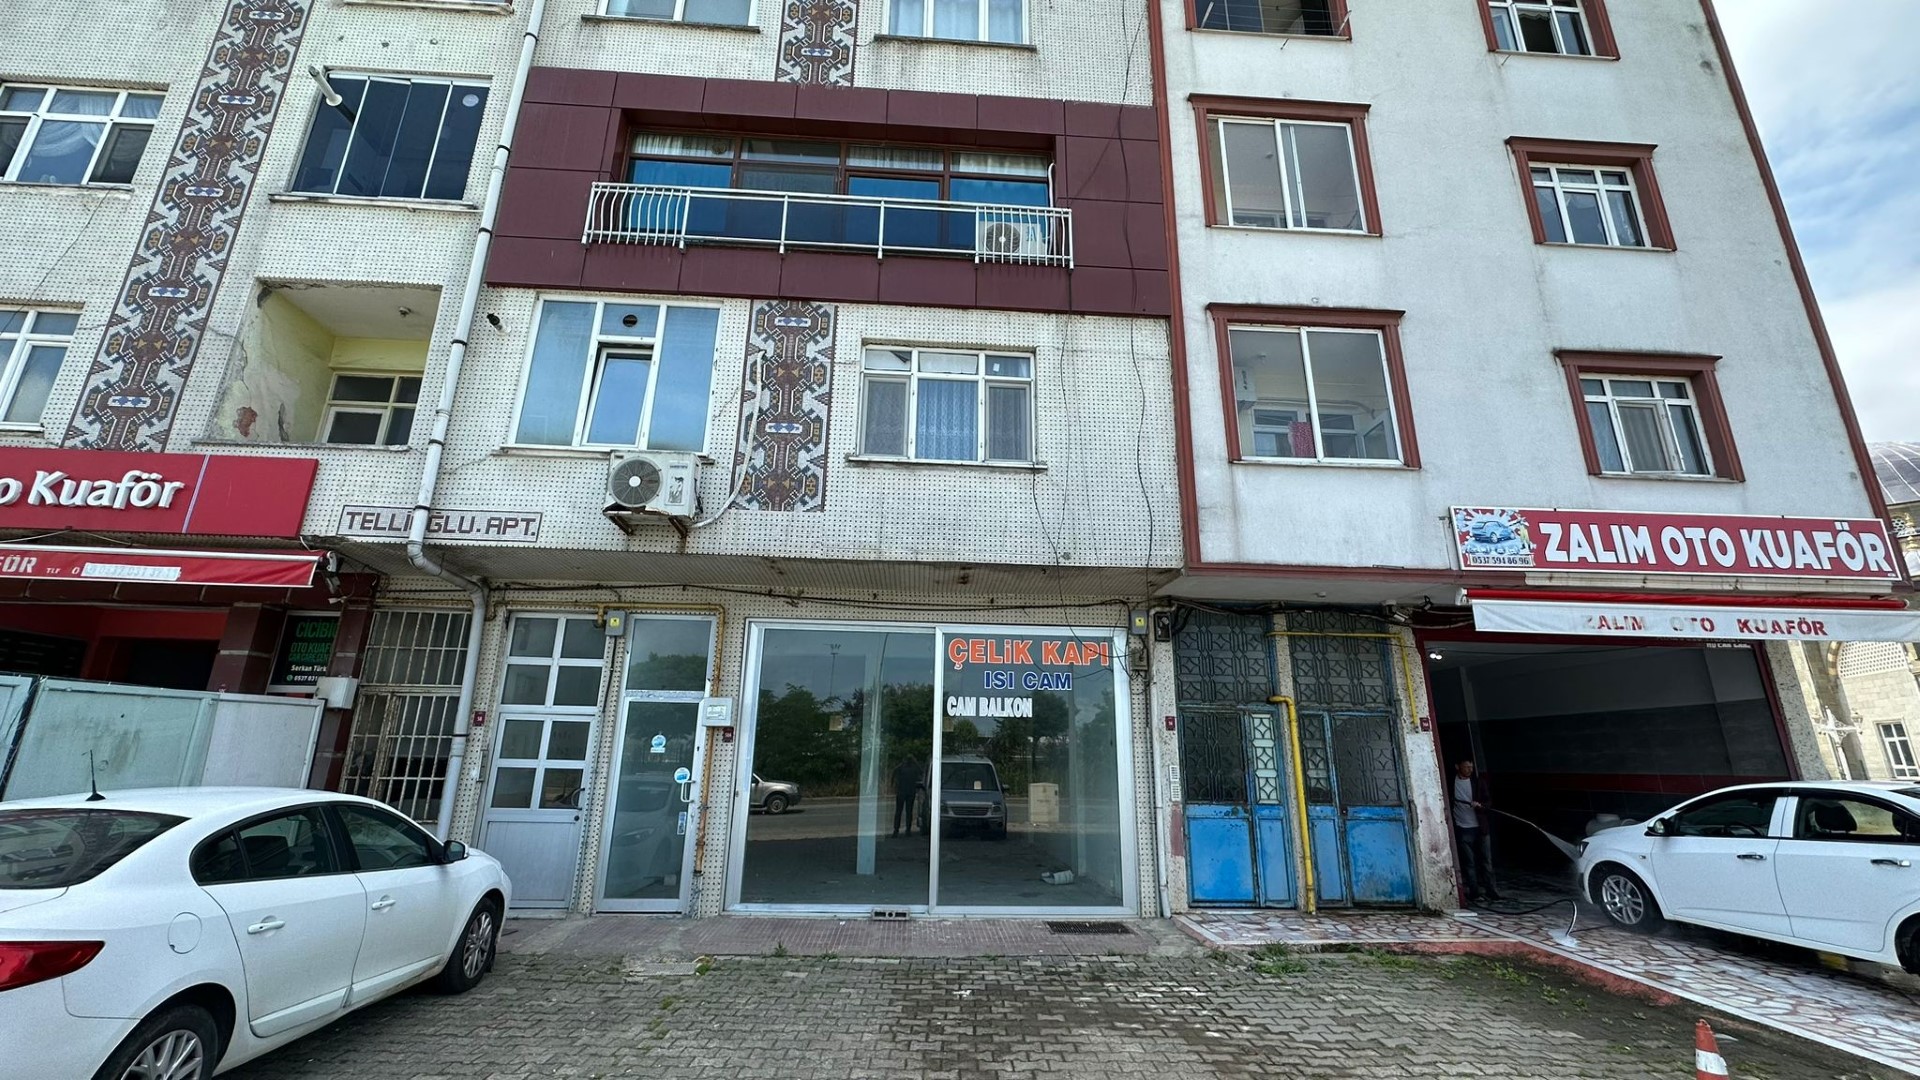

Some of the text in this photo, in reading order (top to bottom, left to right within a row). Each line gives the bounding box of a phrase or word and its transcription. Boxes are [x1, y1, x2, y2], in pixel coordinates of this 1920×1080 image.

[28, 470, 185, 509] Kuaför
[1538, 521, 1893, 572] ZALIM OTO KUAFÖR
[1737, 617, 1828, 635] KUAFÖR
[1041, 640, 1109, 666] KAPI
[984, 671, 1072, 690] ISI CAM
[946, 696, 1033, 718] CAM BALKON
